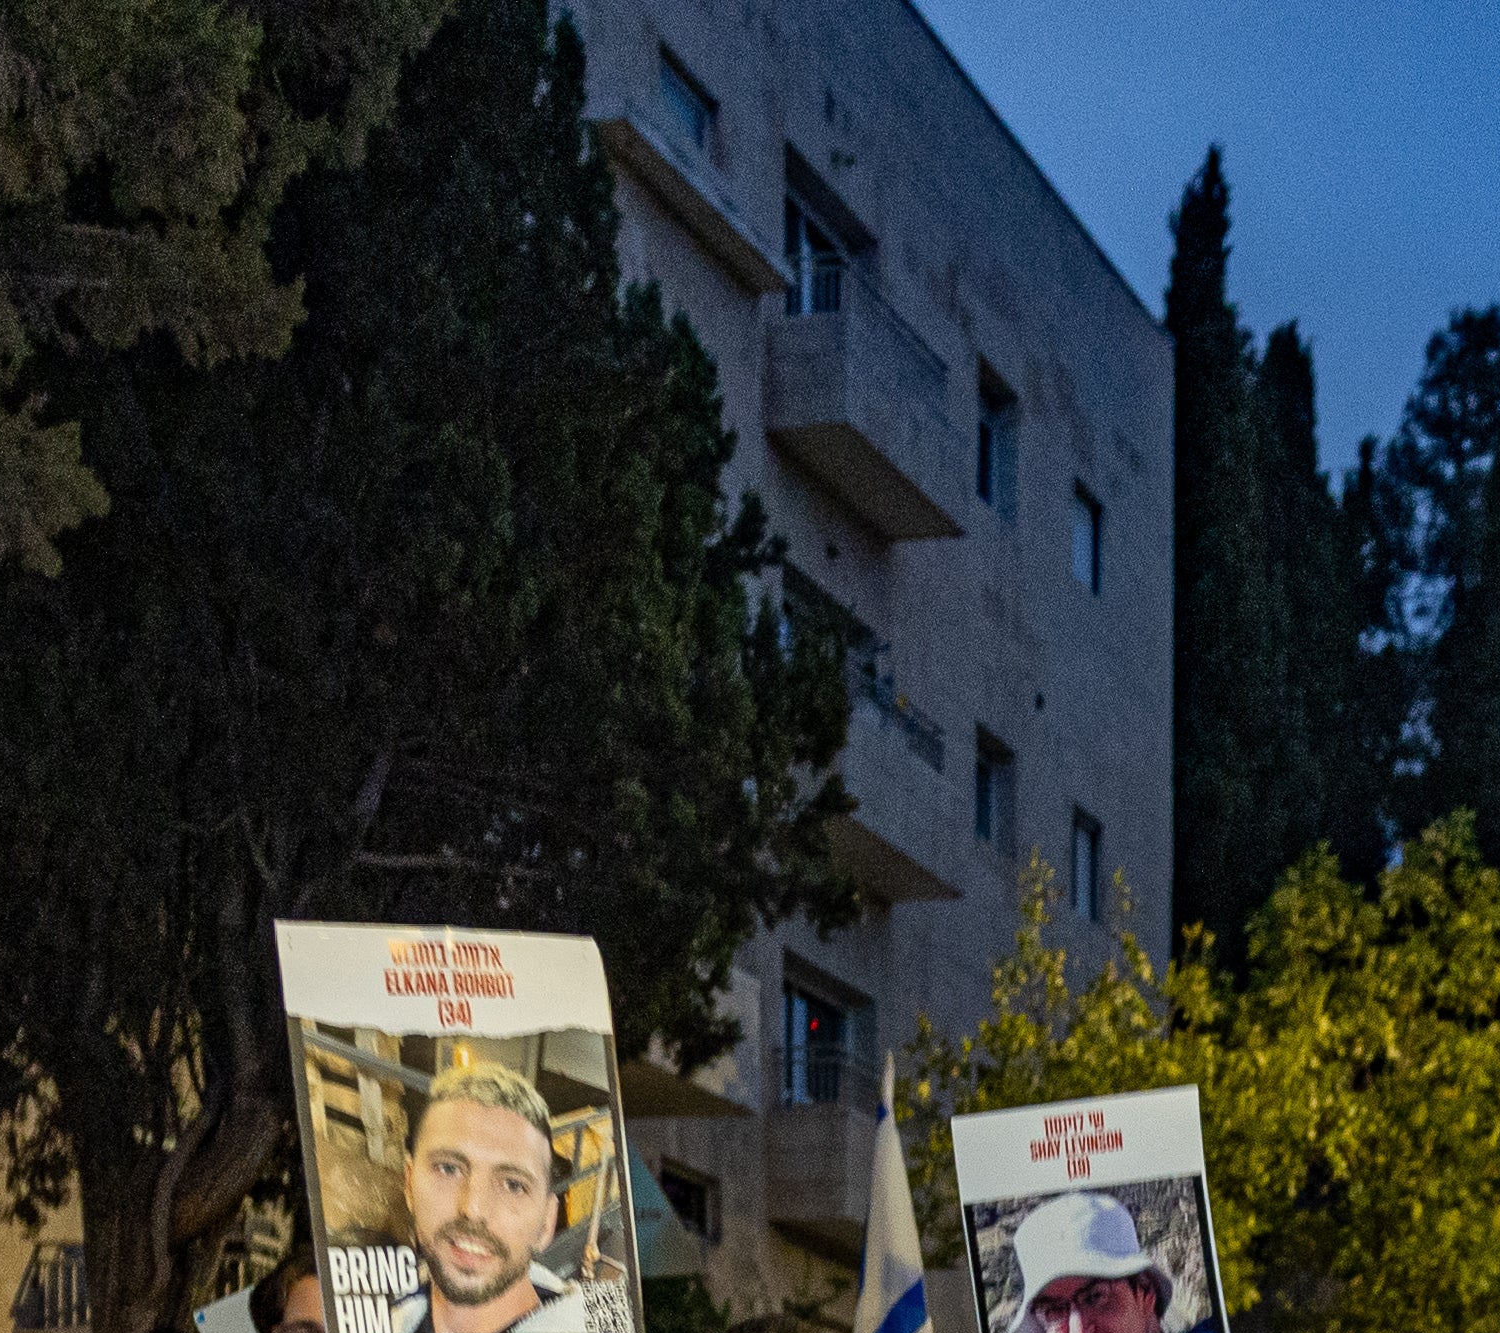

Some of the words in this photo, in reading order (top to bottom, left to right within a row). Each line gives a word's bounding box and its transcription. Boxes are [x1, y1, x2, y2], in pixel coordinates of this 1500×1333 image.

[384, 967, 449, 996] ELKANA
[437, 998, 473, 1029] (34)
[1030, 1139, 1060, 1162] SHAY
[1064, 1128, 1123, 1159] LEVINSON
[327, 1246, 419, 1296] BRING
